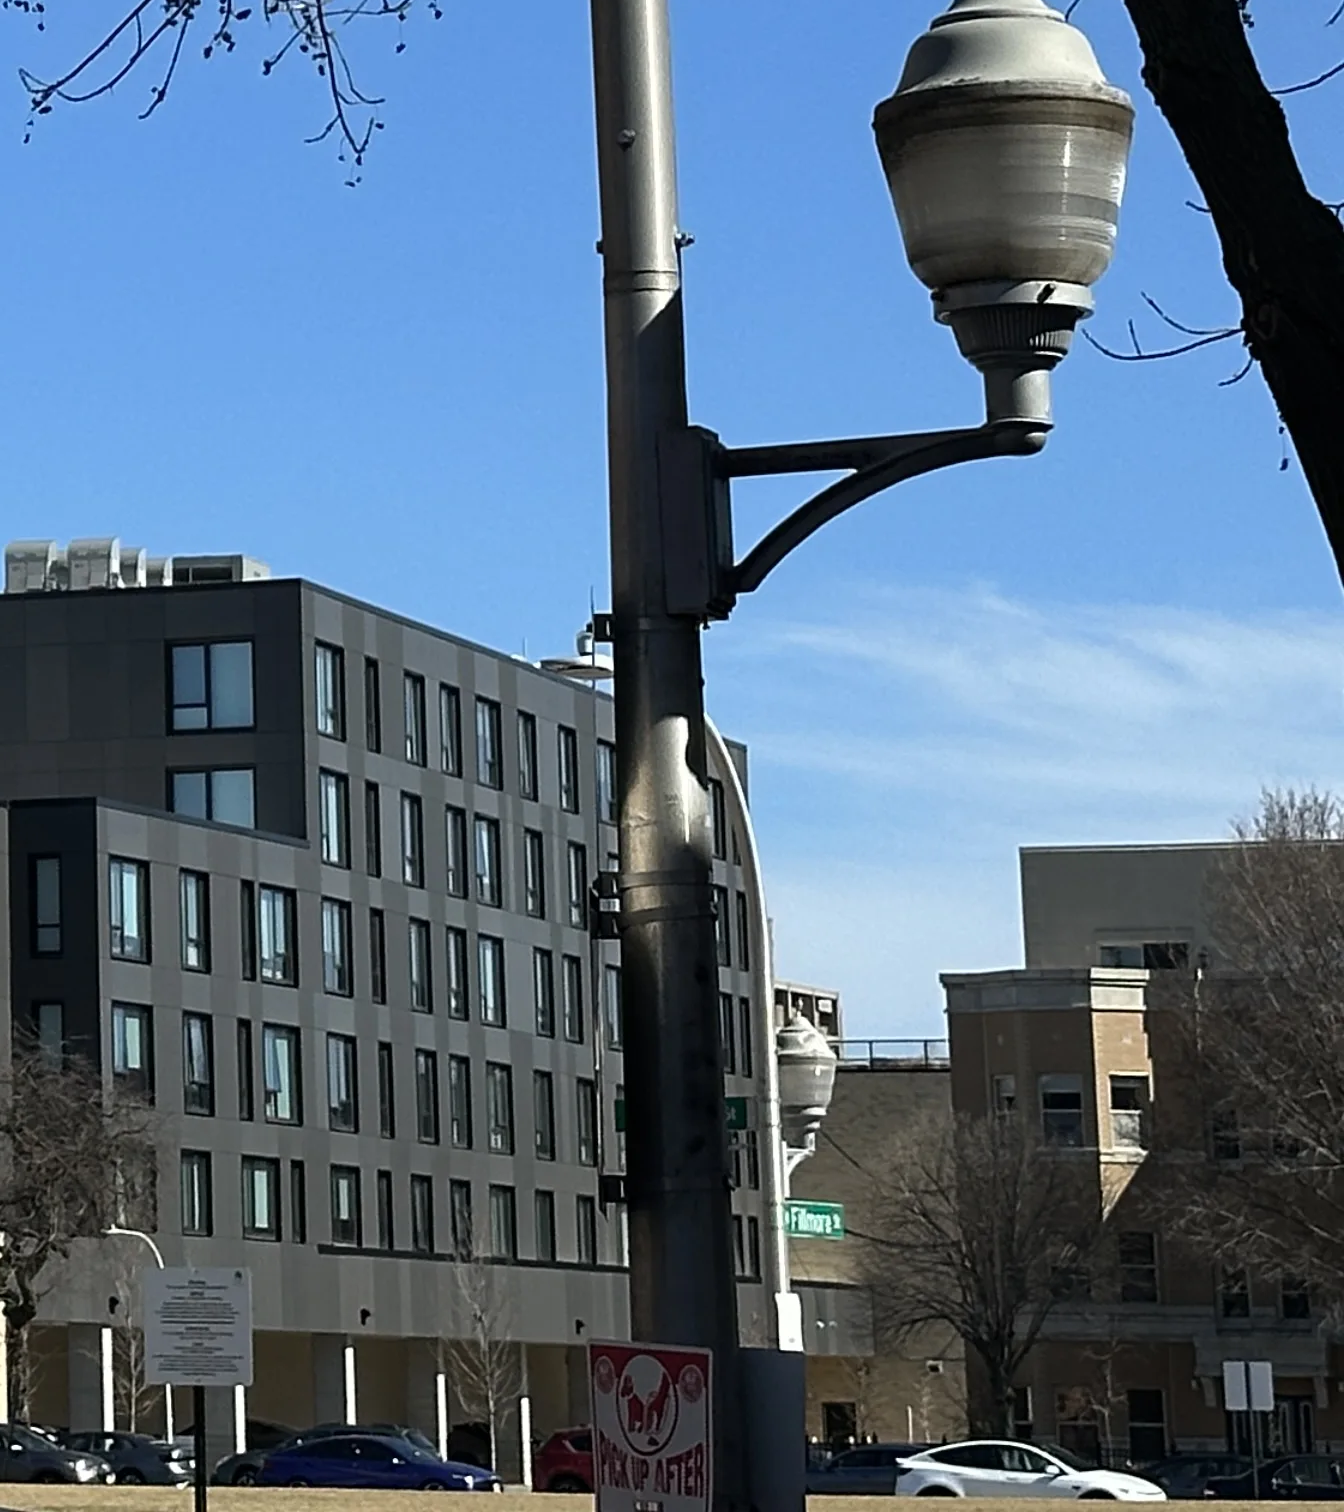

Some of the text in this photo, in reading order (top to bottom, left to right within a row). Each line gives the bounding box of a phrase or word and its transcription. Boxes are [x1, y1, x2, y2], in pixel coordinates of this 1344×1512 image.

[599, 1429, 705, 1499] PICK UP AFTER
